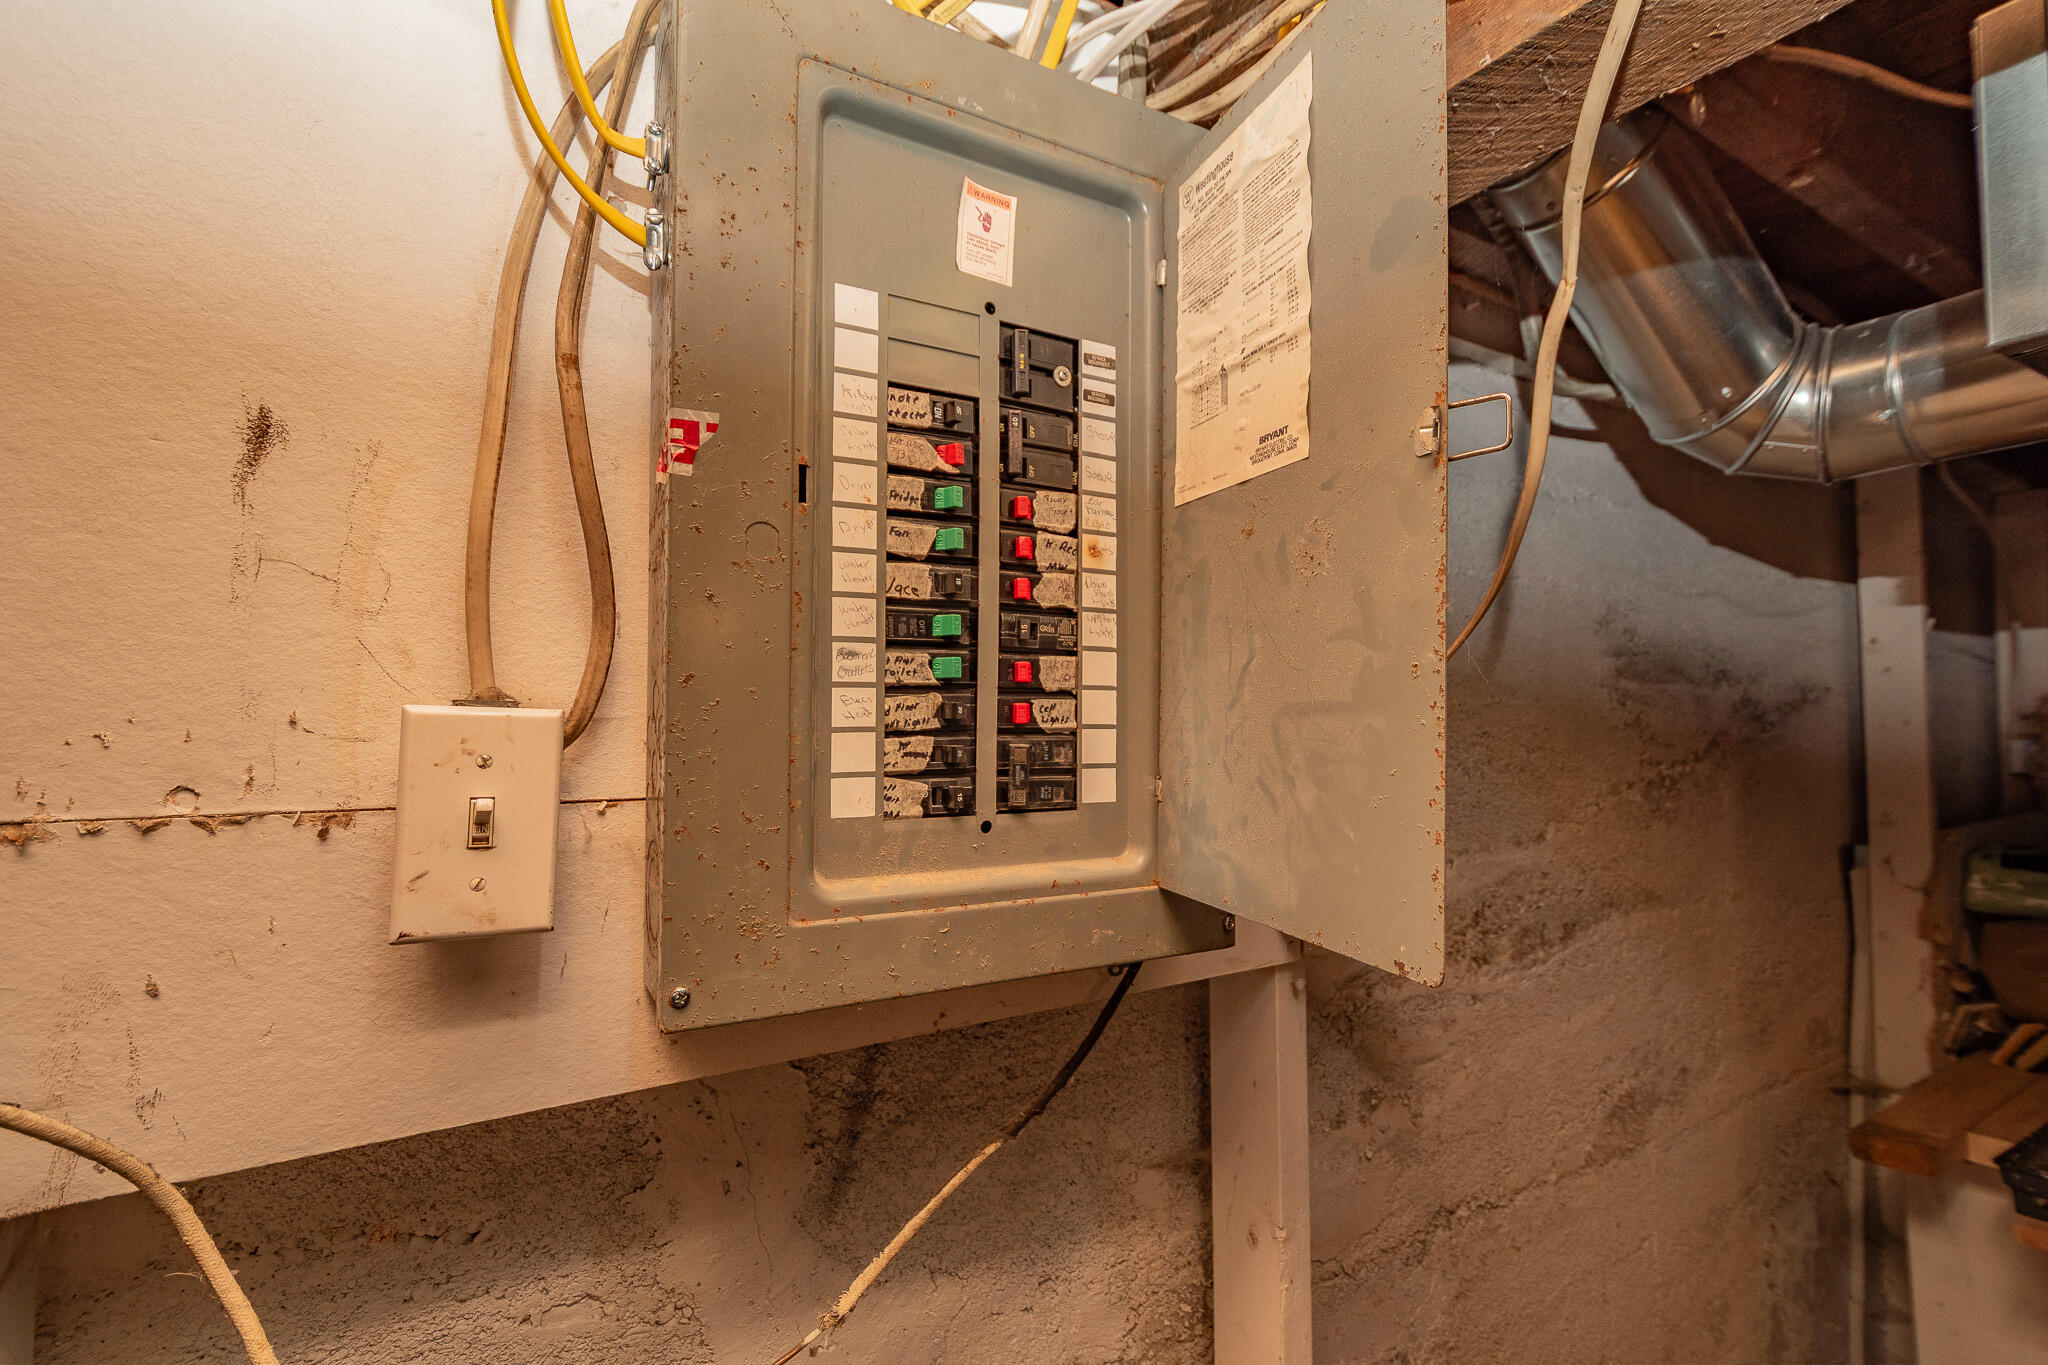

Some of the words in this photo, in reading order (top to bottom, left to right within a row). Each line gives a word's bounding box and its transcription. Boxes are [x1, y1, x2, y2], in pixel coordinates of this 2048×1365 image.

[1196, 150, 1234, 193] Westinghouse
[974, 188, 1010, 209] WARNING
[934, 406, 942, 419] ON
[1012, 416, 1018, 427] 40
[1259, 424, 1288, 445] BRYANT
[1028, 465, 1036, 478] OFF
[889, 489, 921, 507] Fridge
[889, 526, 911, 538] Fan
[1021, 624, 1028, 633] 15
[957, 793, 963, 802] 15
[473, 825, 489, 834] ON
